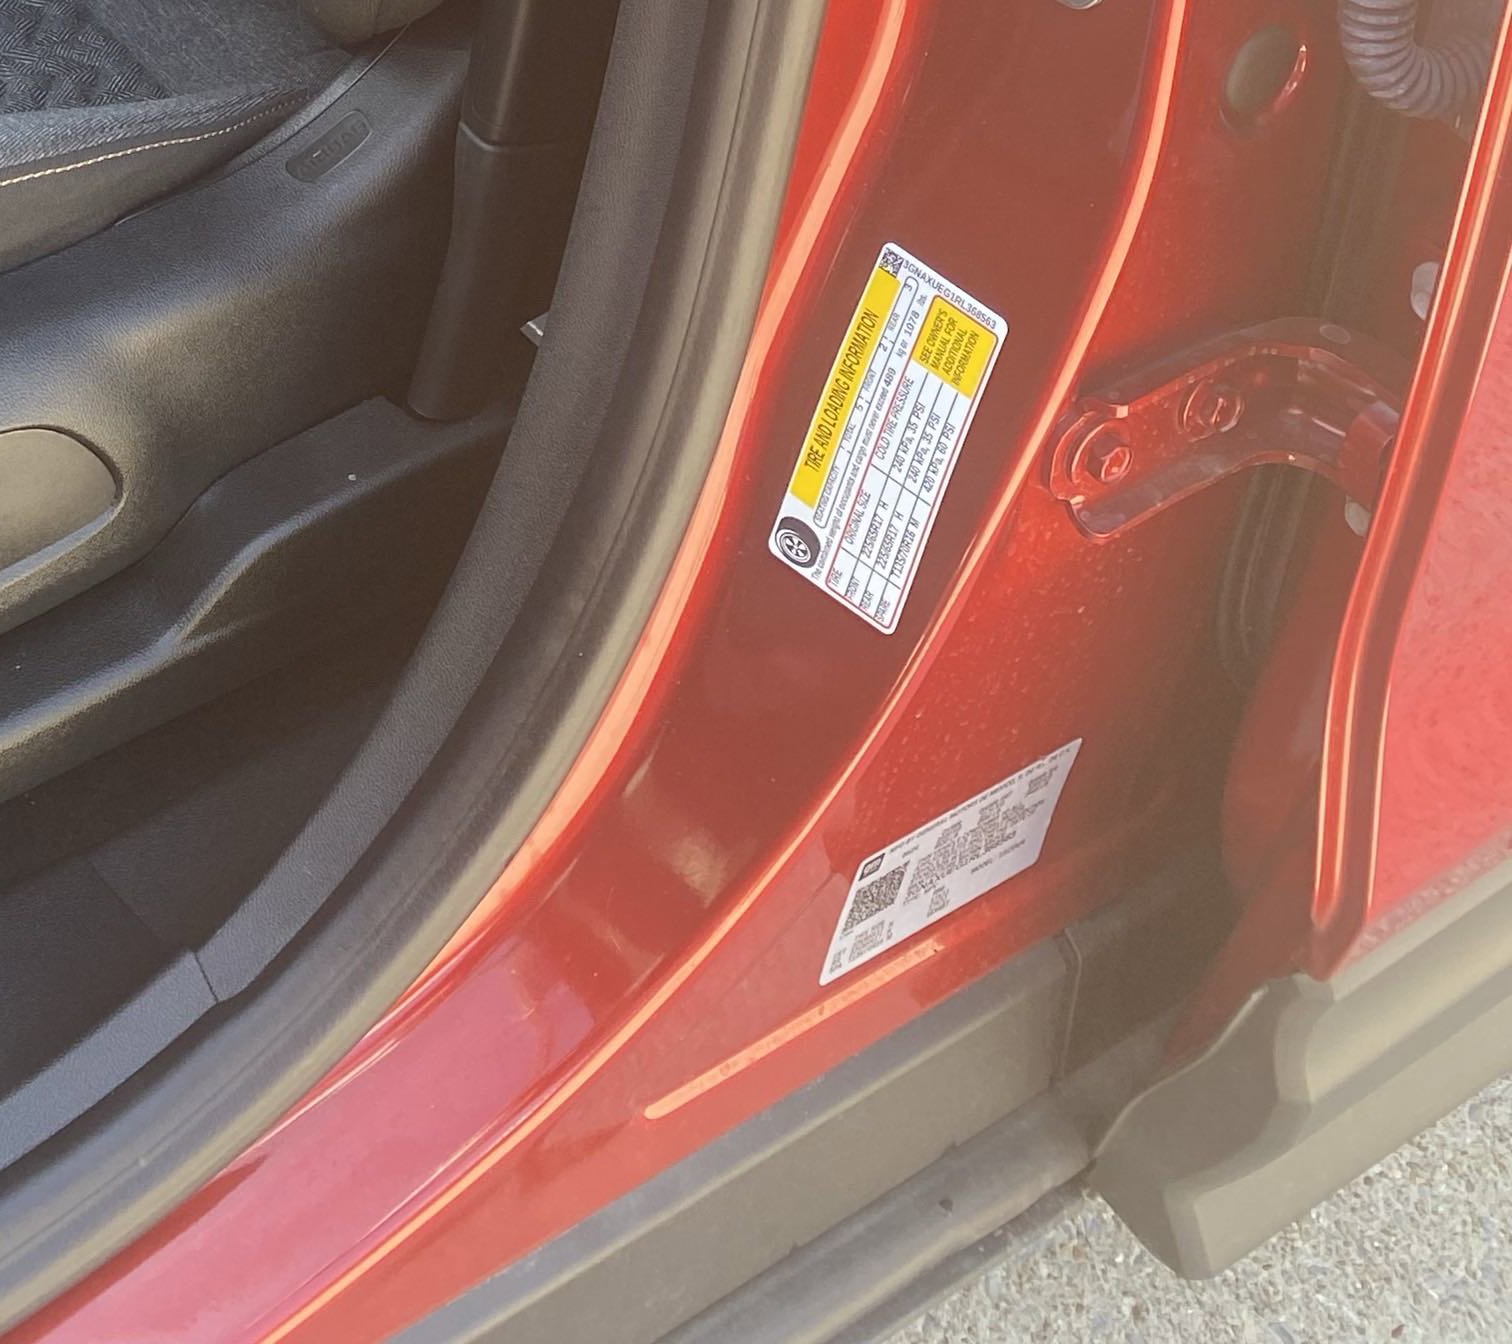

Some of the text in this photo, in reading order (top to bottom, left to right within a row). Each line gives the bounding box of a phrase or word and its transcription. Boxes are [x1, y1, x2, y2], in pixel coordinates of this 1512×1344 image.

[903, 309, 920, 337] 1078
[919, 307, 948, 365] SEE OWNER'S
[930, 316, 957, 371] MANUAL FOR
[941, 325, 968, 376] ADDITIONAL
[950, 328, 979, 386] INFORMATION
[803, 306, 879, 473] TIRE AND LOADING INFORMATION
[907, 419, 918, 434] 35
[912, 401, 925, 420] PSI
[927, 411, 941, 430] PSI
[922, 430, 933, 445] 35
[892, 454, 906, 473] 240
[907, 464, 921, 483] 240
[922, 474, 936, 494] 420
[936, 440, 948, 455] 60
[942, 421, 955, 440] PSI
[828, 375, 914, 588] TIRE ORIGINAL SIZE COLD TIRE PRESSURE
